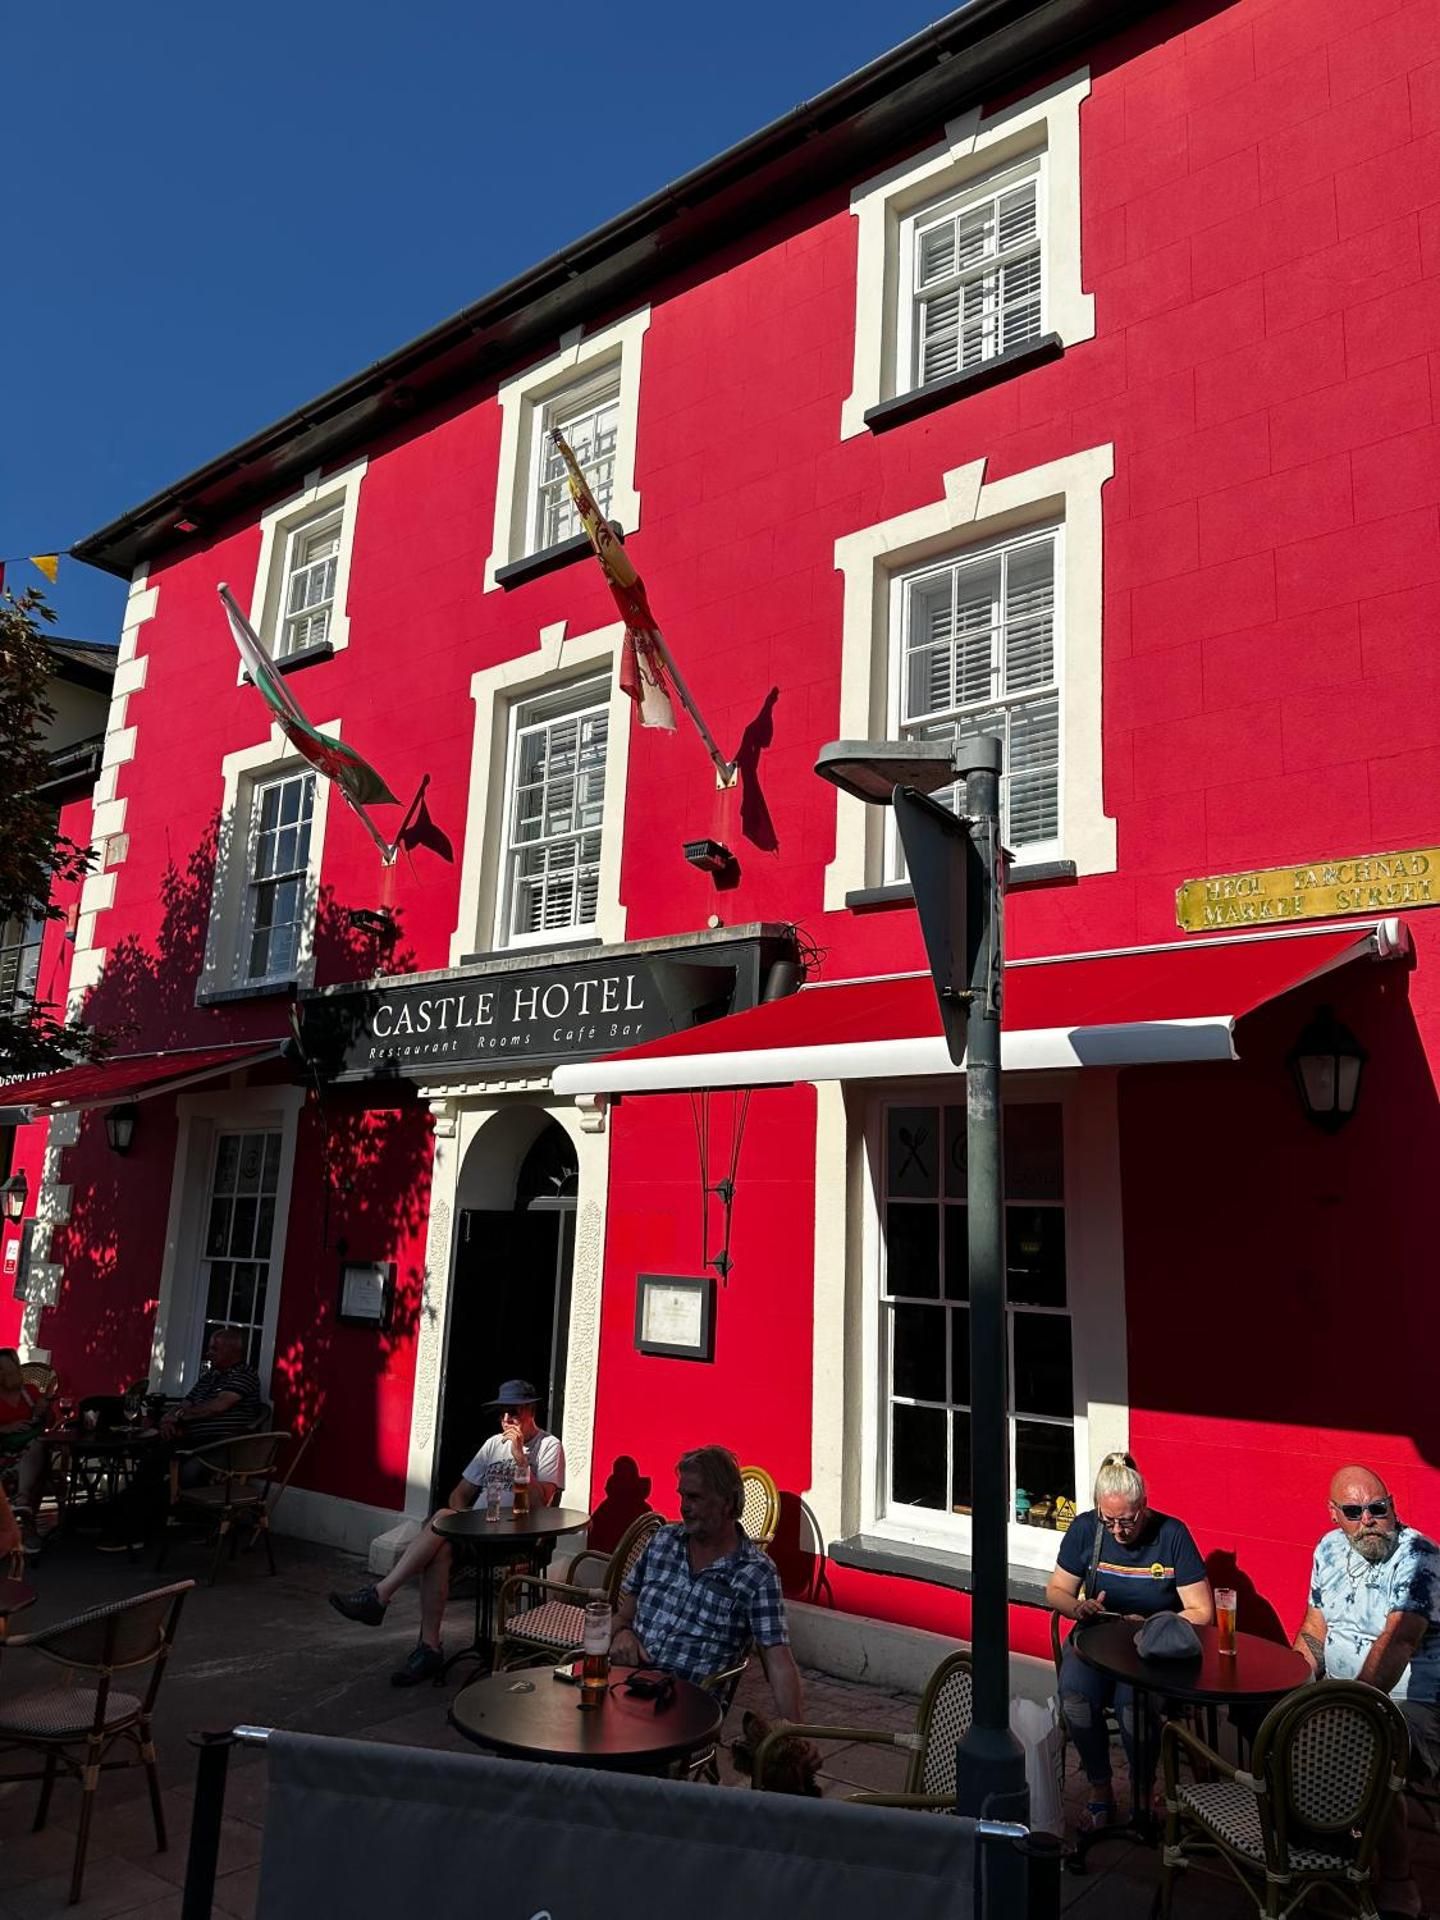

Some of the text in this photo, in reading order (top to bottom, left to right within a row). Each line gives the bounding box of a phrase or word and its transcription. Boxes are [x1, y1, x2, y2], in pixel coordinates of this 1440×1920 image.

[1203, 879, 1433, 925] MARKET STREET
[1205, 877, 1265, 901] HEOL
[372, 975, 645, 1037] CASTLE HOTEL
[369, 1039, 458, 1060] Restaurant
[477, 1034, 531, 1049] Rooms
[610, 1023, 643, 1037] Bar
